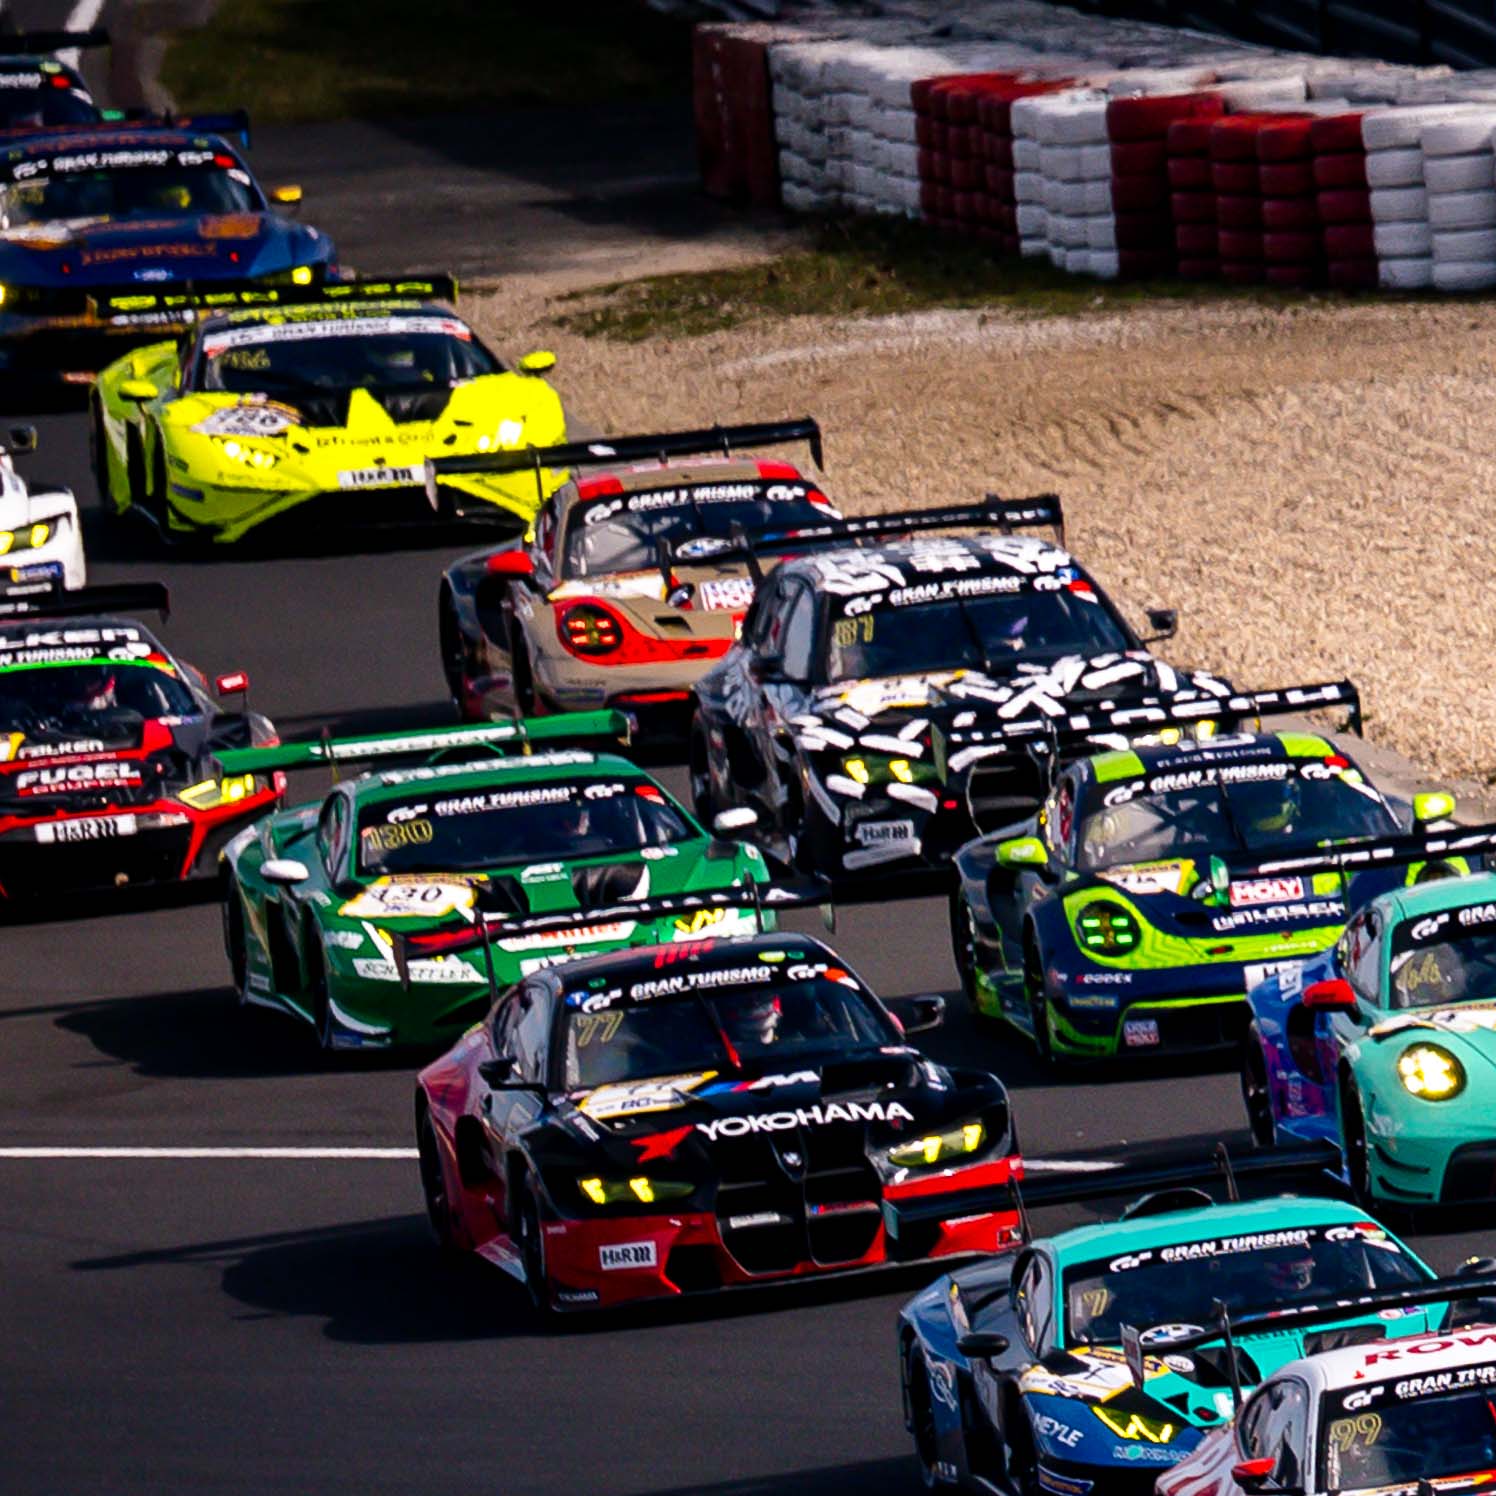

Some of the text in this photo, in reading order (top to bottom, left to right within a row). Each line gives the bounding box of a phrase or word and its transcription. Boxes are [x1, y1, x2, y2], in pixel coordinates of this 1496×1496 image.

[631, 966, 772, 1001] GRAN TURISMO
[696, 1102, 914, 1142] YOKOHAMA
[1160, 1230, 1309, 1263] GRAN TURISMO
[1395, 1371, 1452, 1396] GRAN
[1330, 1412, 1383, 1452] 99
